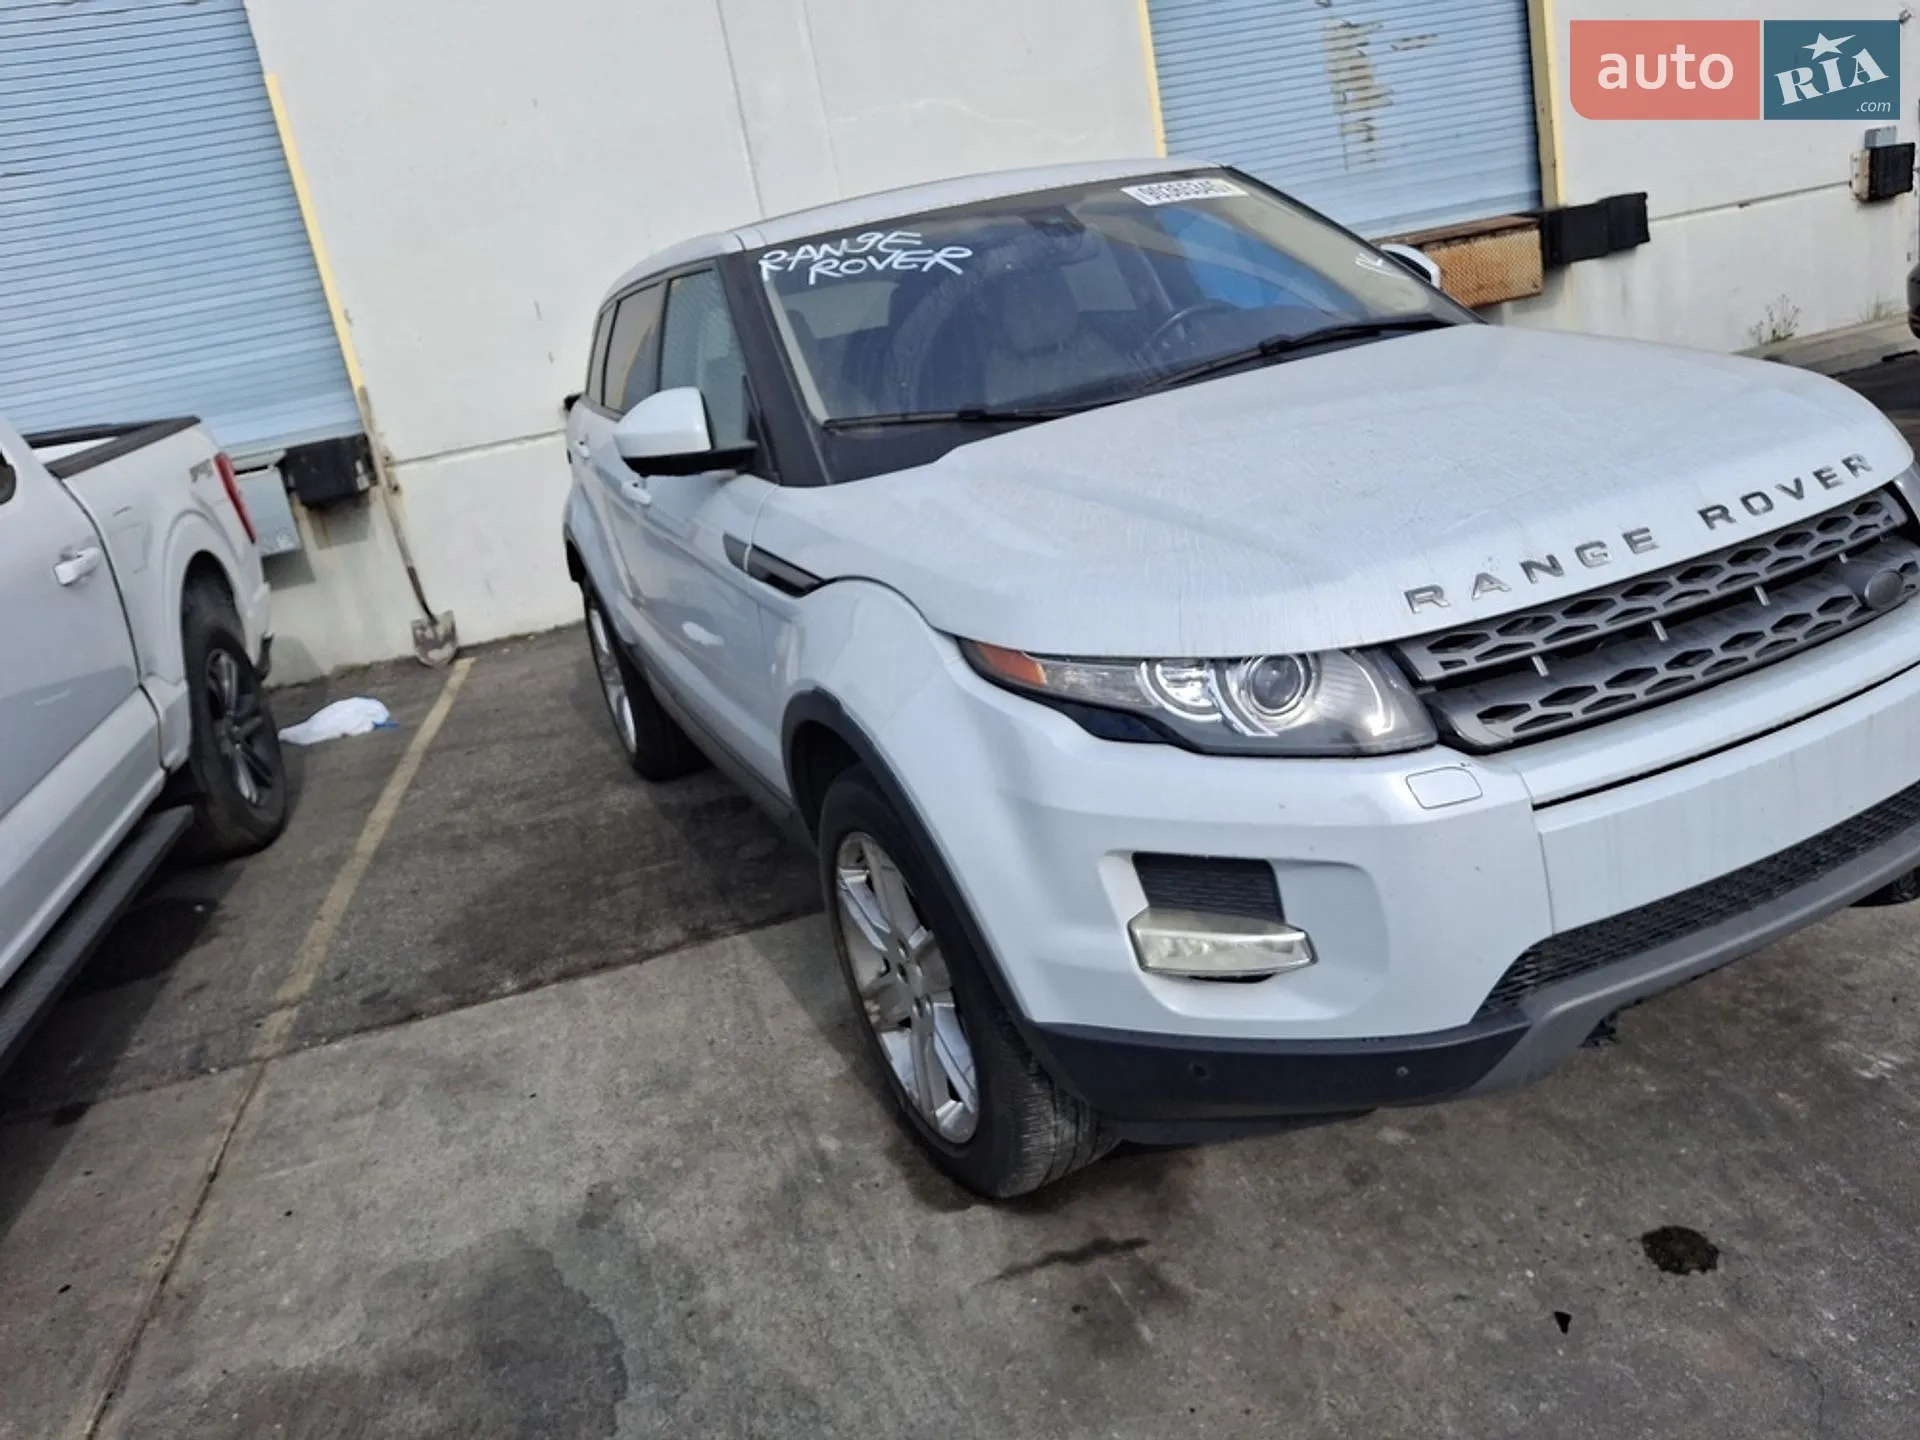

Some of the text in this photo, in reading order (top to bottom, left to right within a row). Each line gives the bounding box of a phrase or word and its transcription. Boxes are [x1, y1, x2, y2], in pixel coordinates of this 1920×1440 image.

[808, 245, 974, 286] ROVER
[1403, 452, 1874, 615] RANGE ROVER
